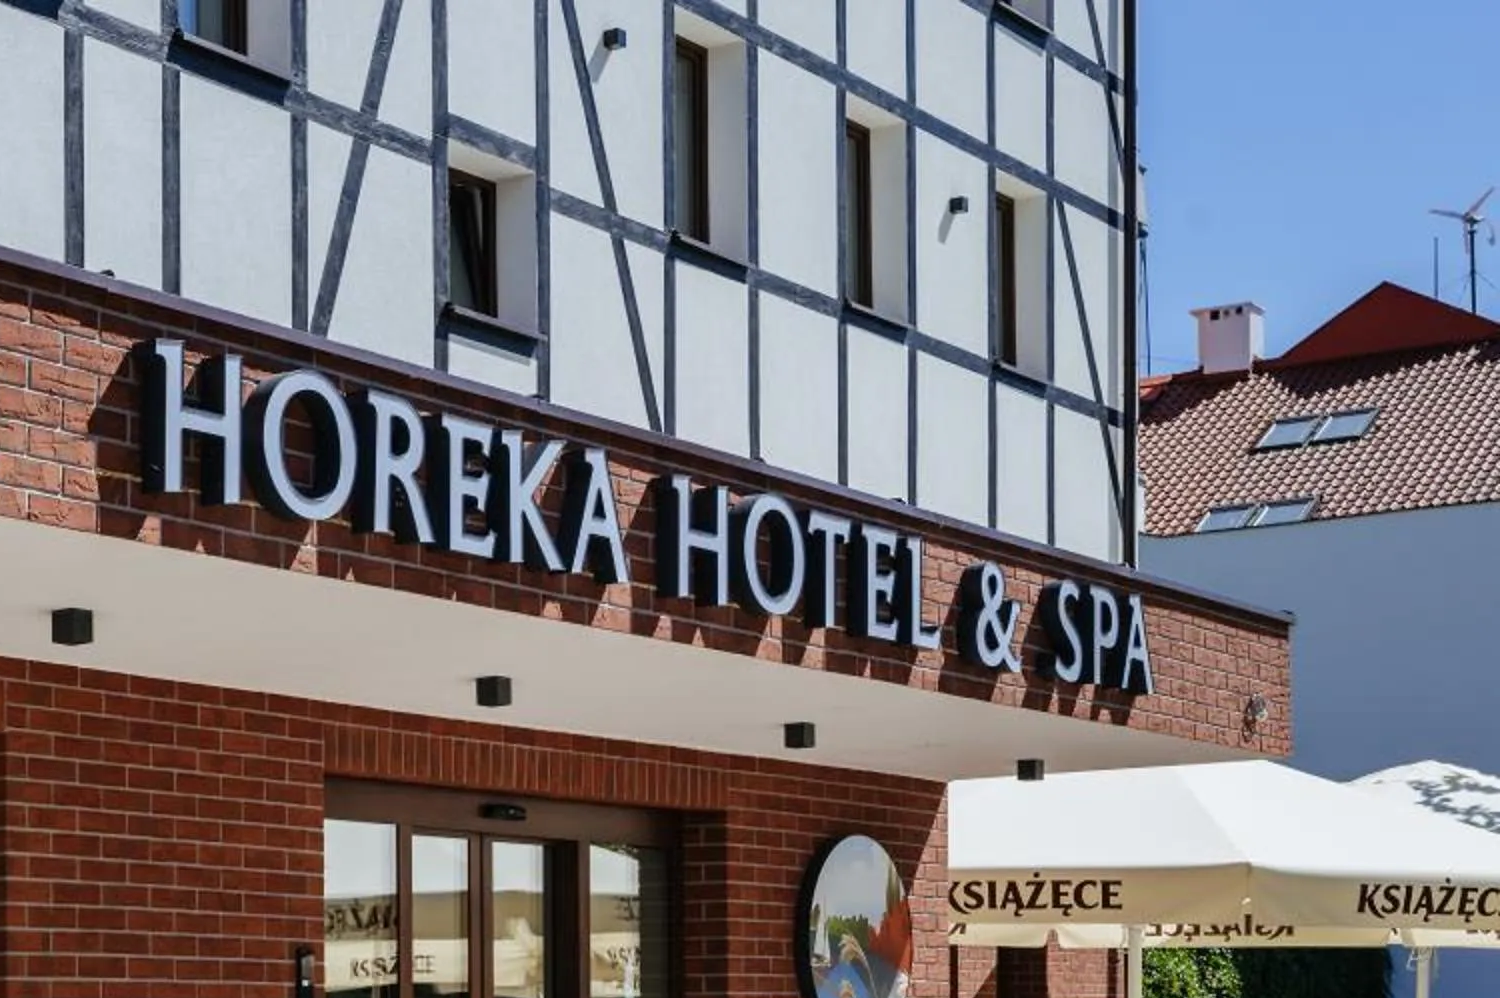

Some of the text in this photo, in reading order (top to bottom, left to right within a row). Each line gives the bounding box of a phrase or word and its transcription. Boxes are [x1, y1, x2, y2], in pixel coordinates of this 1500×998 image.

[155, 338, 1155, 695] HOREKA HOTEL & SPA
[1357, 877, 1500, 922] KSIĄŻĘC
